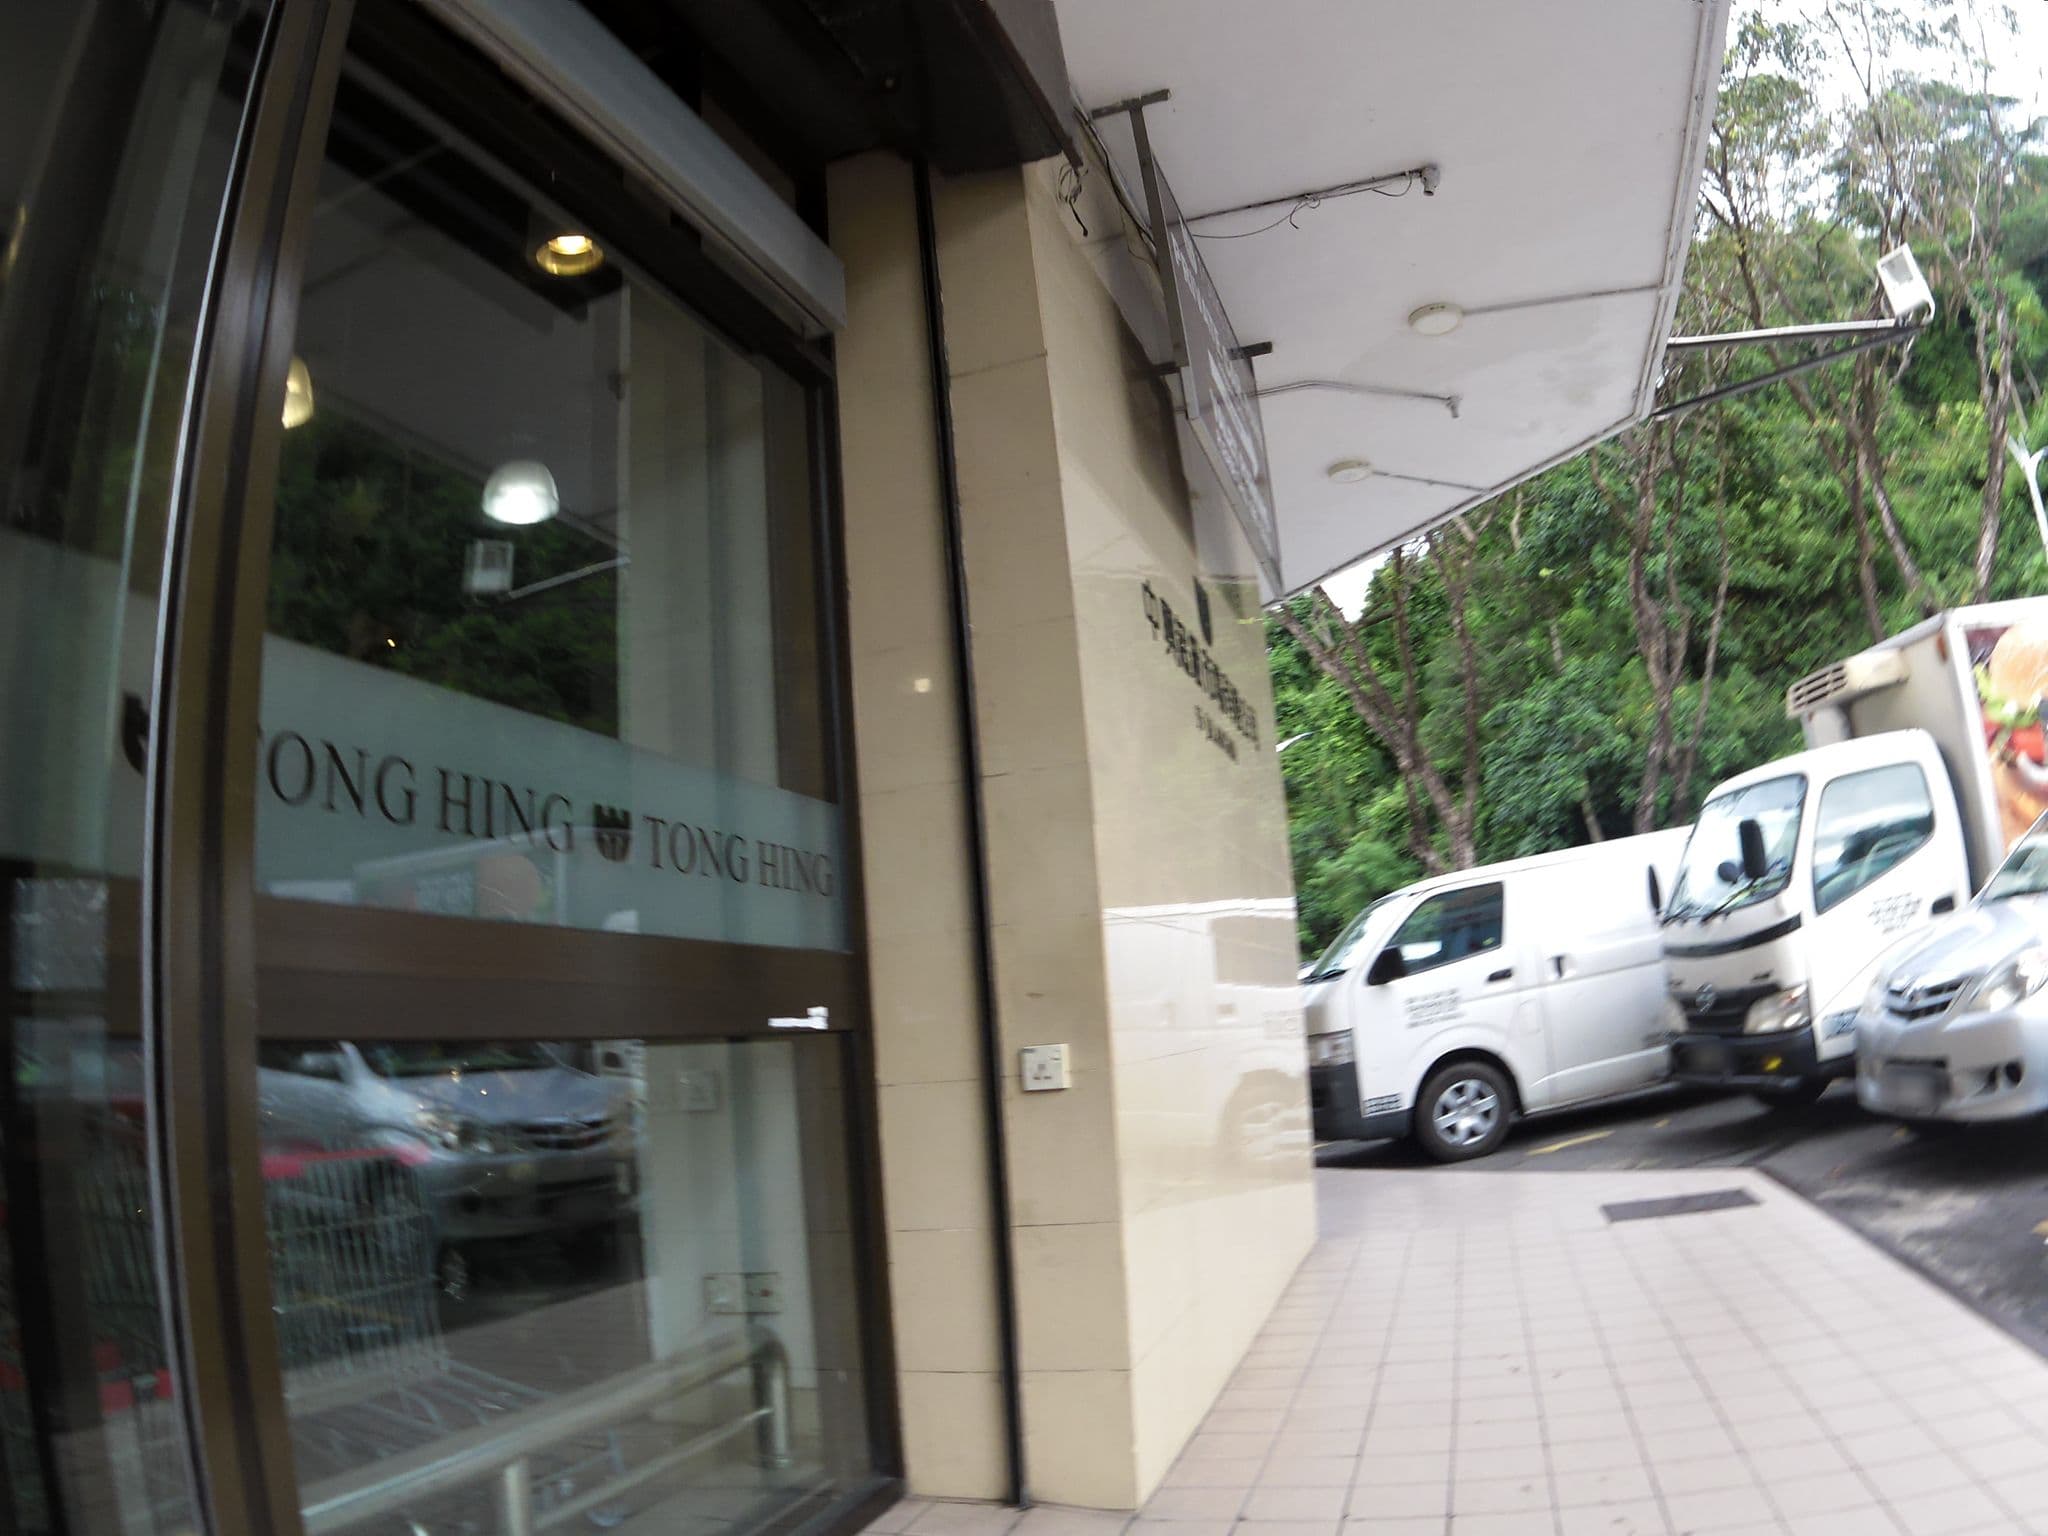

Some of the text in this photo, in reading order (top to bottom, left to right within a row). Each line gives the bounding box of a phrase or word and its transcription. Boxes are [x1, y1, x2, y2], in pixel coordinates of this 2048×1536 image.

[257, 726, 575, 852] ONG HING
[643, 814, 832, 897] TONG HING
